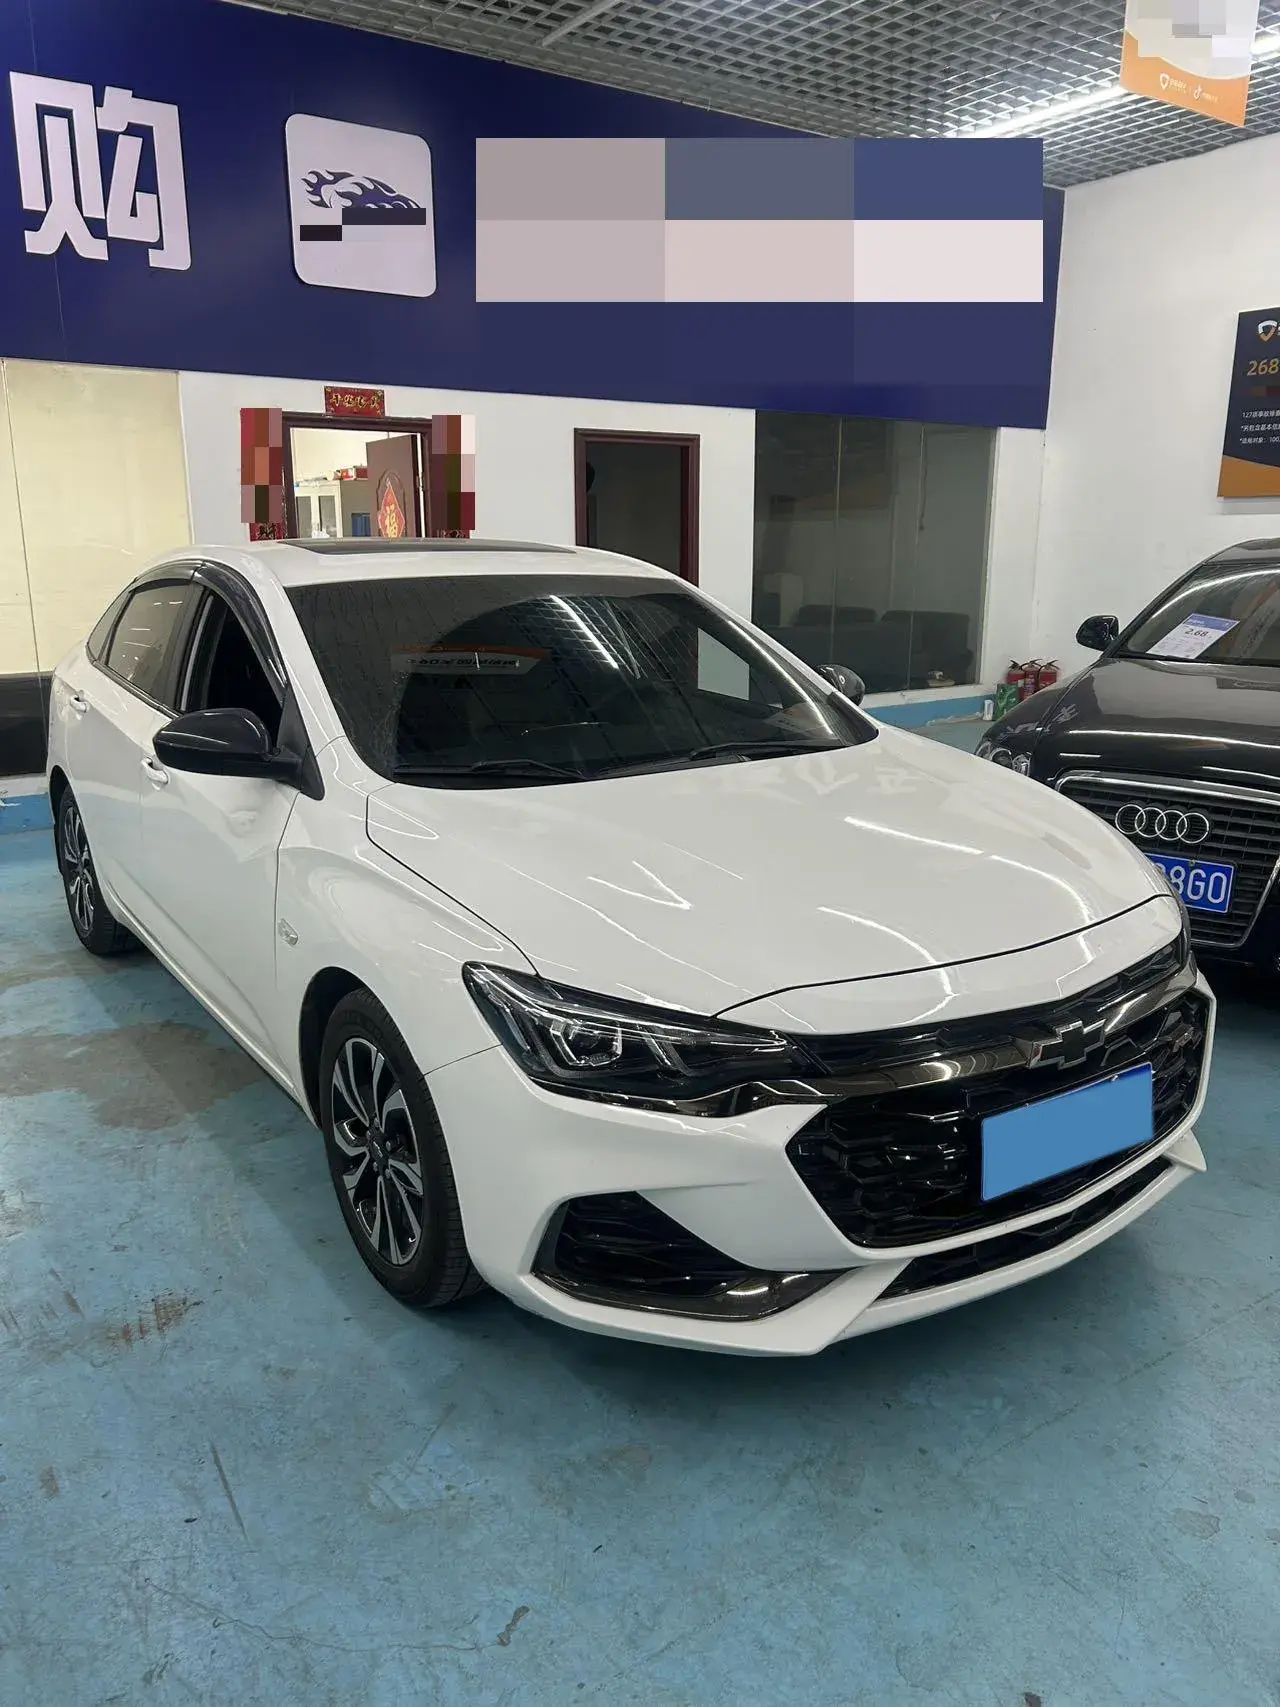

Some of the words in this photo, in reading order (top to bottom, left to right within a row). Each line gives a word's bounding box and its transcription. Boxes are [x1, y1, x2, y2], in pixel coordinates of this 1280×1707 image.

[10, 72, 191, 271] 购
[385, 504, 398, 537] 福
[1184, 628, 1209, 637] 2.68
